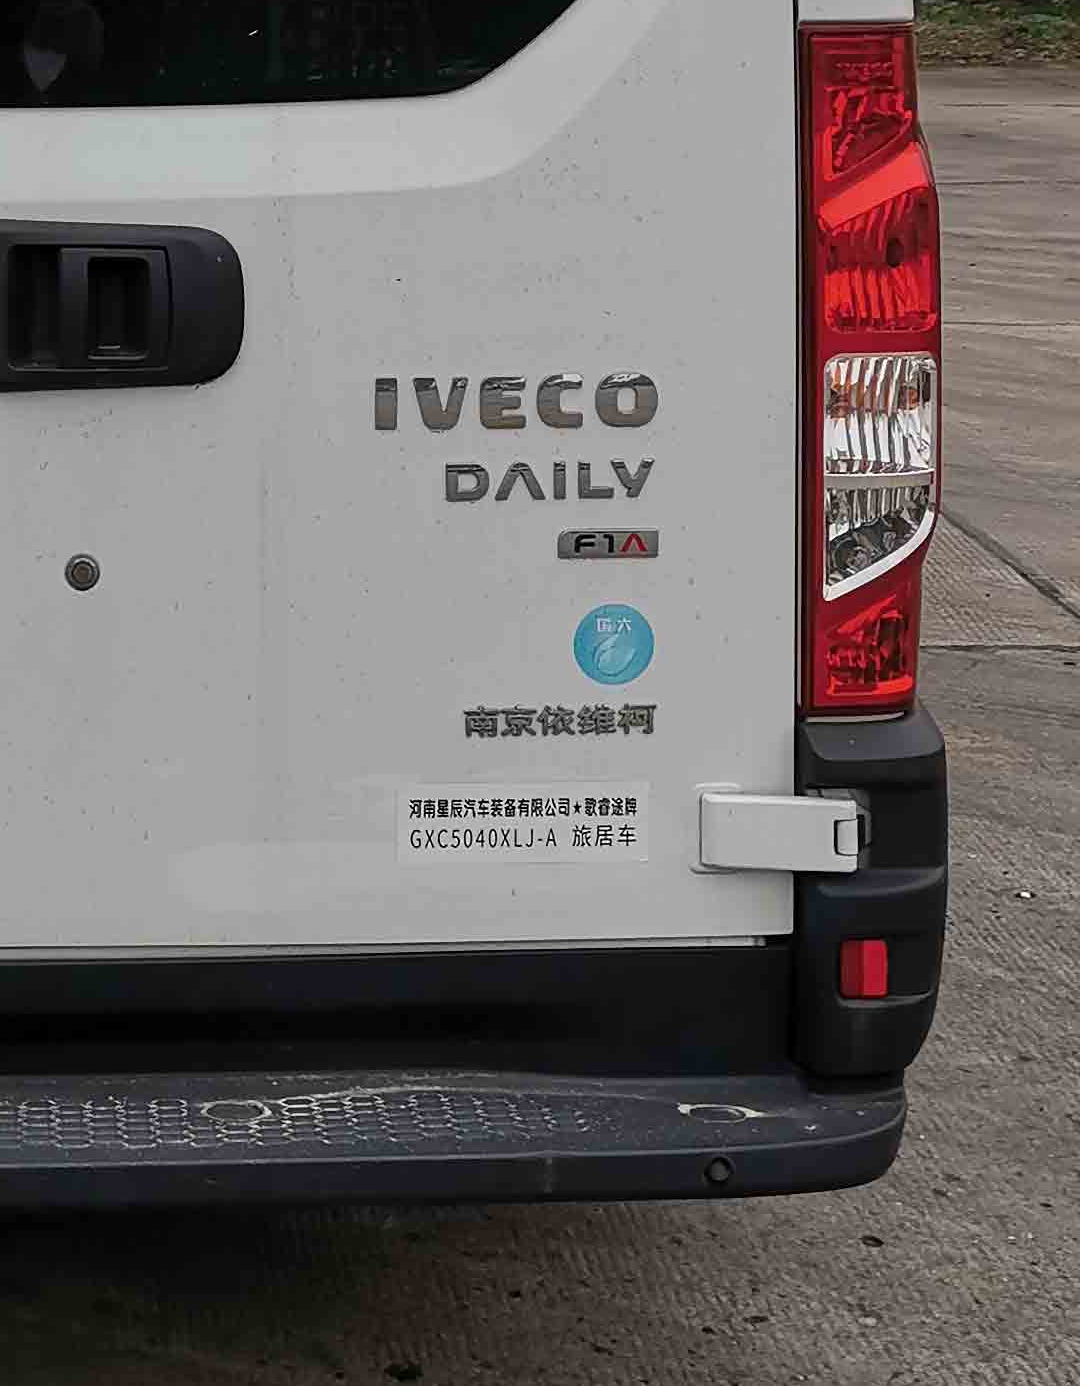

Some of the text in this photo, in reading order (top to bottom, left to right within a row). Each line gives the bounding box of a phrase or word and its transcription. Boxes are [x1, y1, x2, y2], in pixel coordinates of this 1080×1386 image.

[374, 374, 658, 430] IVECO
[445, 458, 655, 502] DAILY
[573, 533, 648, 554] F1A
[463, 704, 657, 738] 南京依维柯
[410, 824, 637, 849] GXC5040XLJ-A 旅居车
